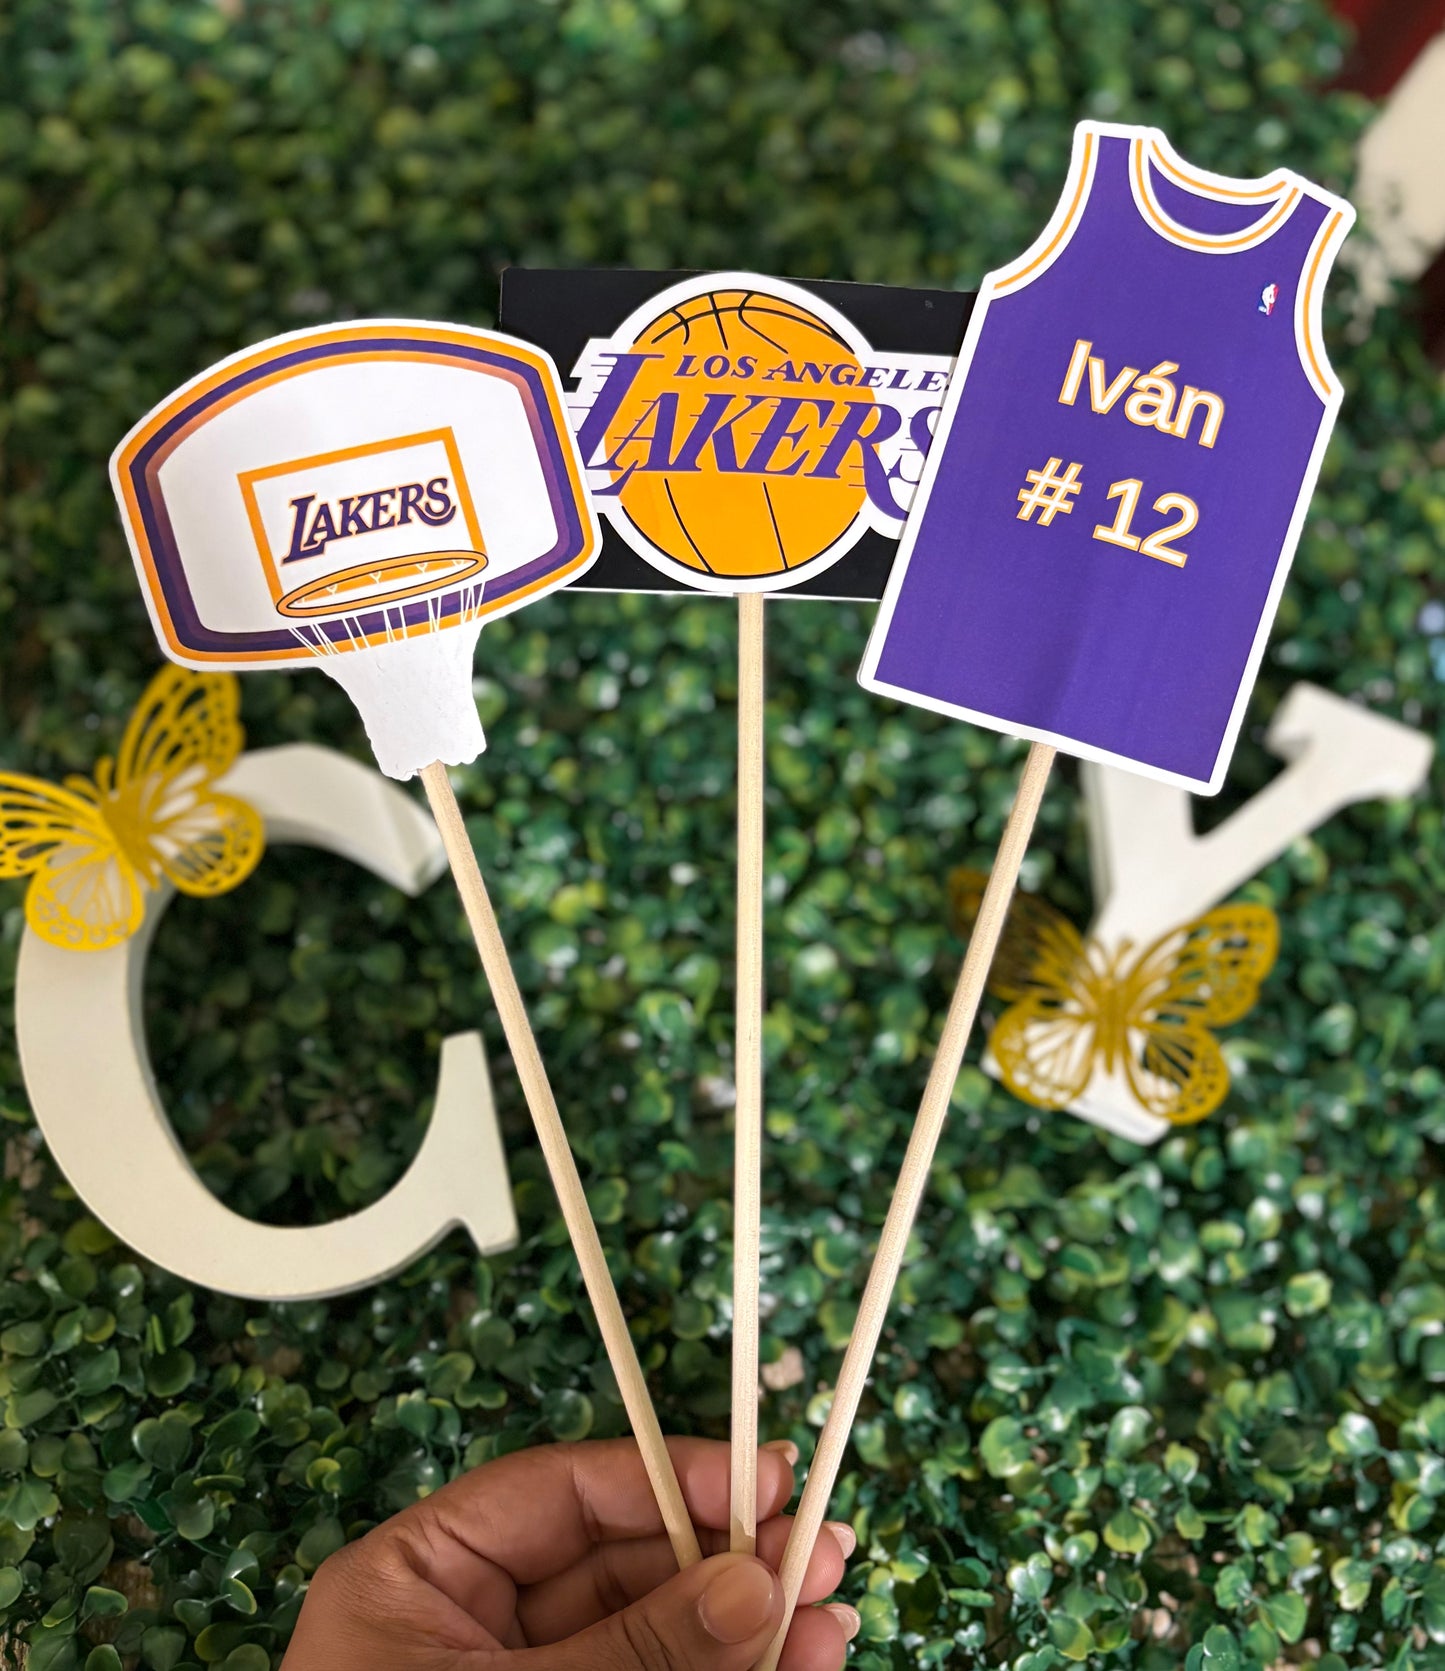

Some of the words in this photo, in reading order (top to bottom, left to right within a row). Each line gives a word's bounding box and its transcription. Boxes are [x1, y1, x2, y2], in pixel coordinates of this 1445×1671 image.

[673, 354, 758, 380] LOS
[762, 360, 951, 392] ANGELE
[1058, 339, 1225, 449] Iván
[282, 478, 456, 564] LAKERS
[1016, 457, 1083, 526] #
[1092, 478, 1199, 568] 12
[15, 742, 519, 1301] C
